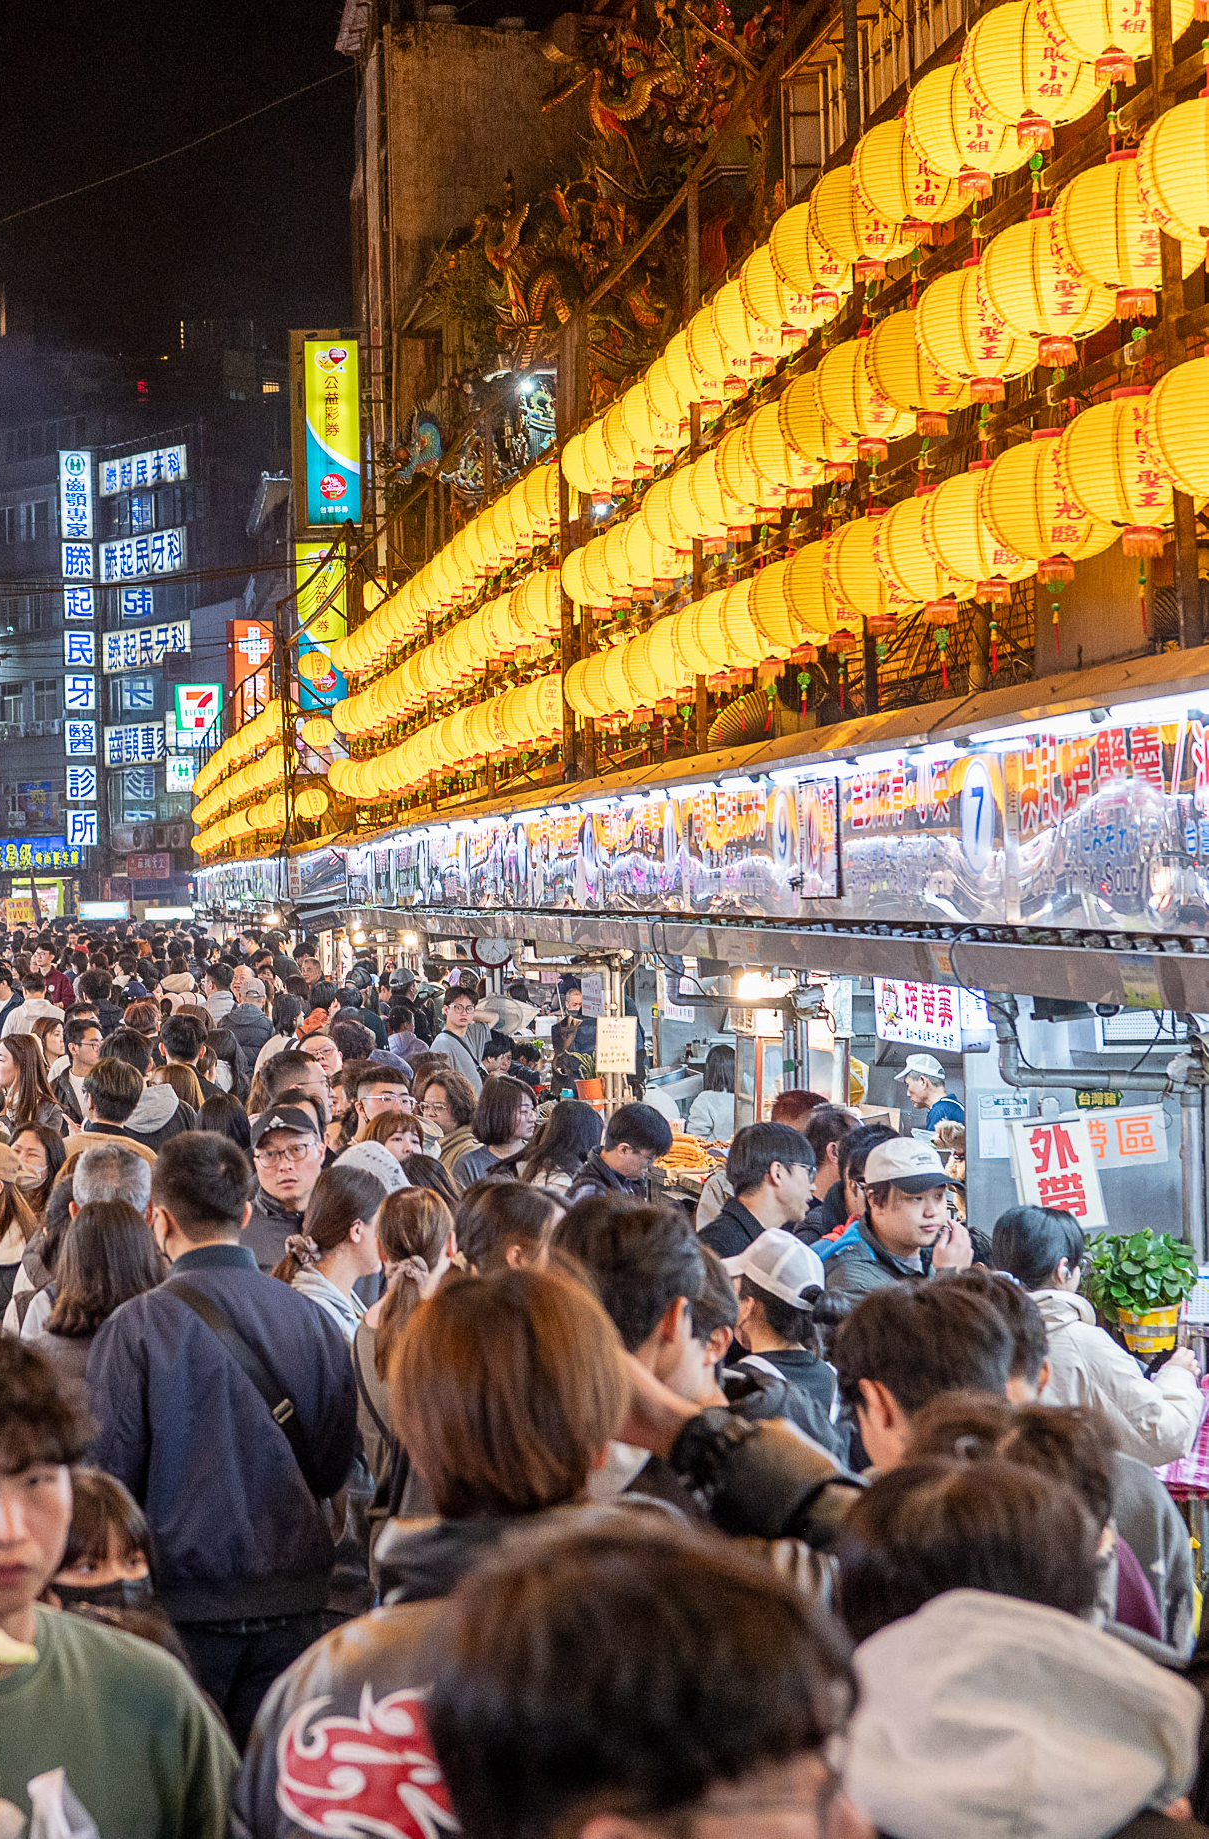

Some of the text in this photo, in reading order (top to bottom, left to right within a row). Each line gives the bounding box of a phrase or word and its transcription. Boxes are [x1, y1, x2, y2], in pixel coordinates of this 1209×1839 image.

[324, 376, 340, 437] 公益彩券
[65, 478, 88, 537] 齒顎專家
[186, 691, 213, 728] 7
[969, 786, 984, 856] 7
[1029, 1124, 1088, 1217] 外帶
